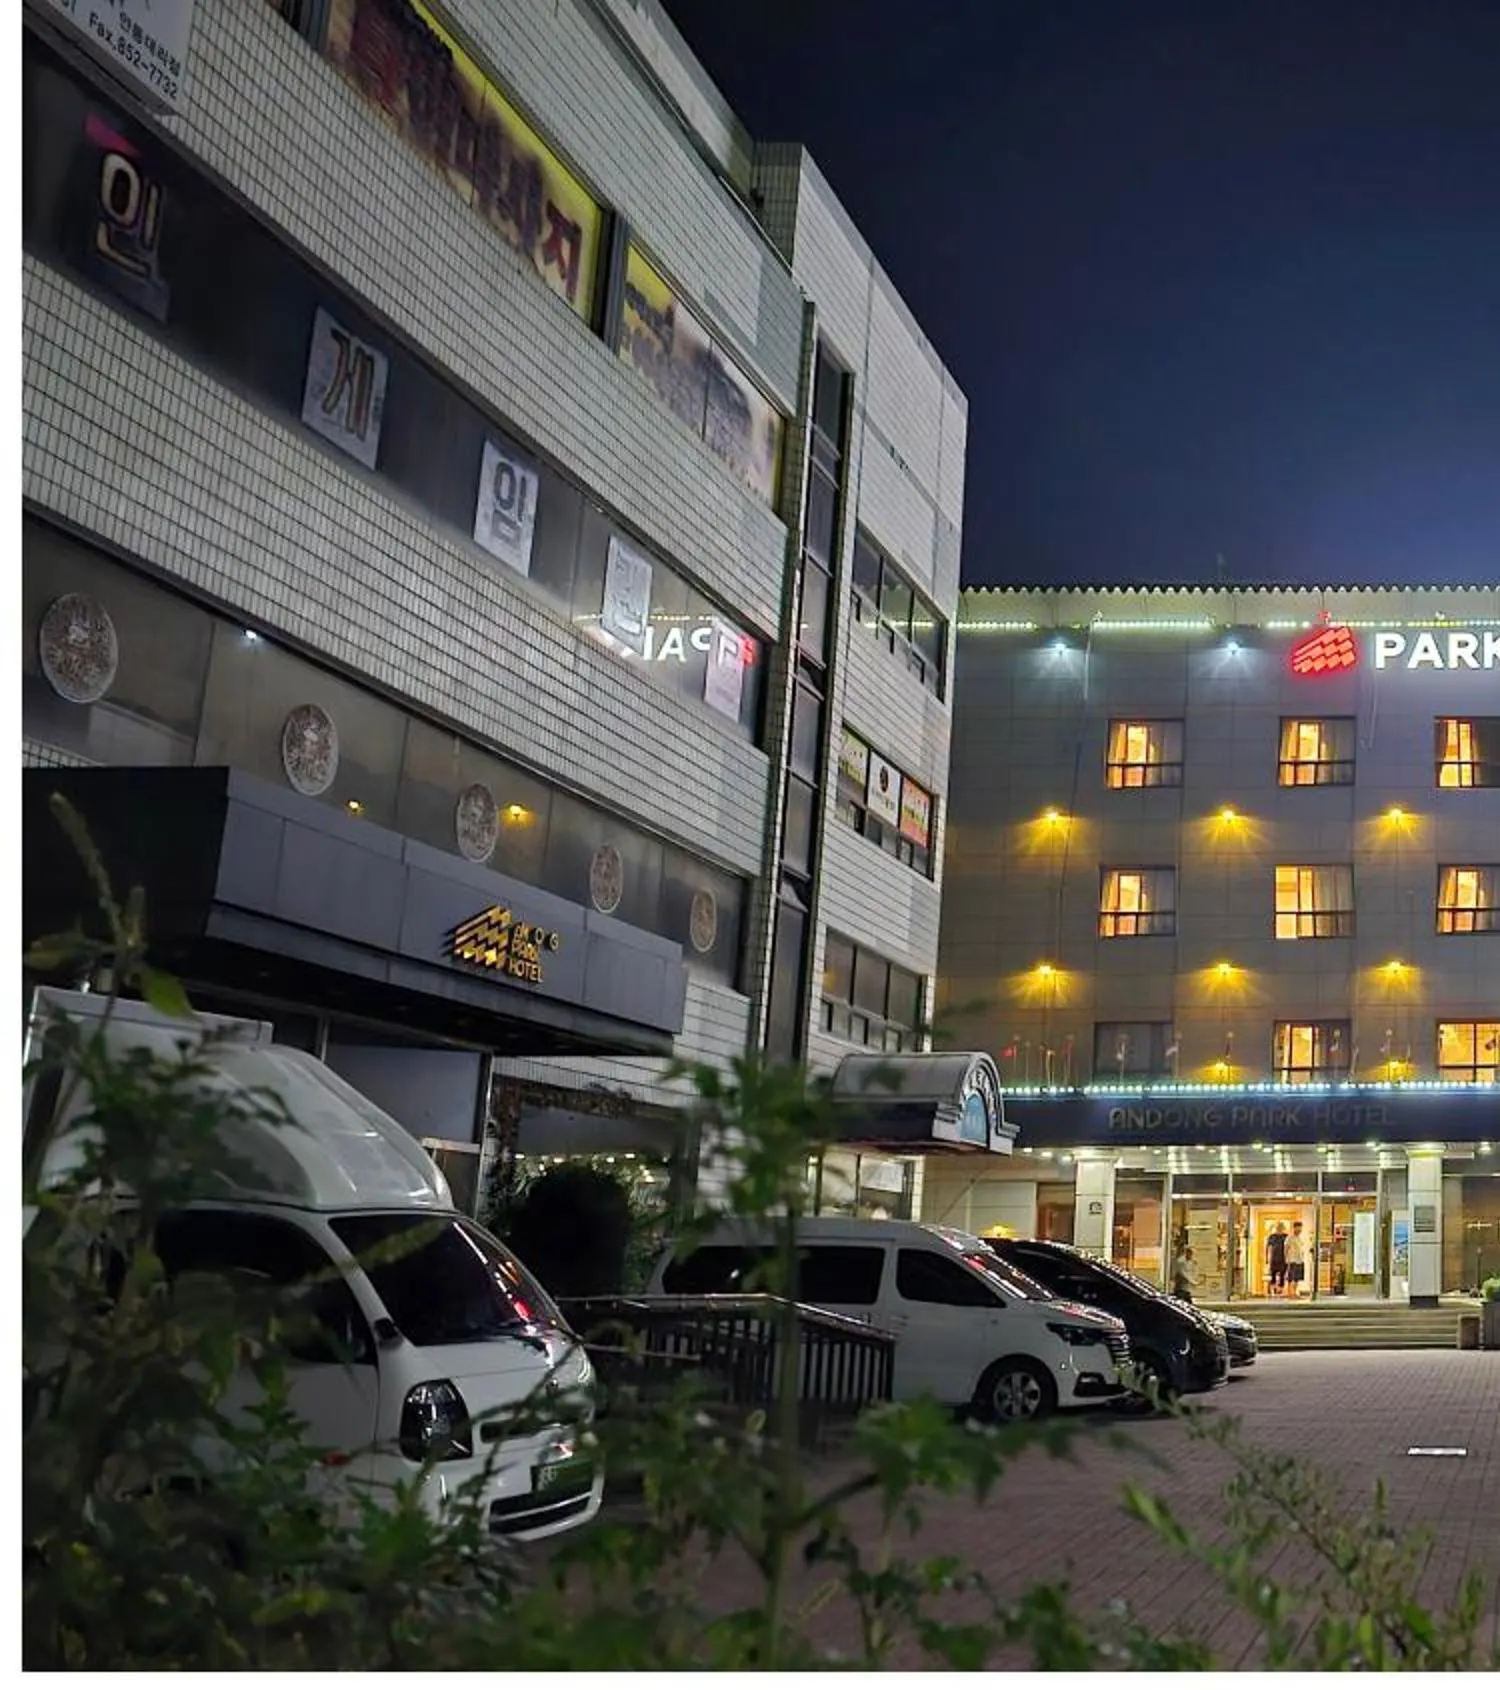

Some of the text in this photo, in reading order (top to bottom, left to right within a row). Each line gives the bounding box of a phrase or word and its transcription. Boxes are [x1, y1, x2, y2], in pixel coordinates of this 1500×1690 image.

[508, 958, 544, 983] HOTEL
[1108, 1104, 1396, 1129] ANDONG PARK HOTEL
